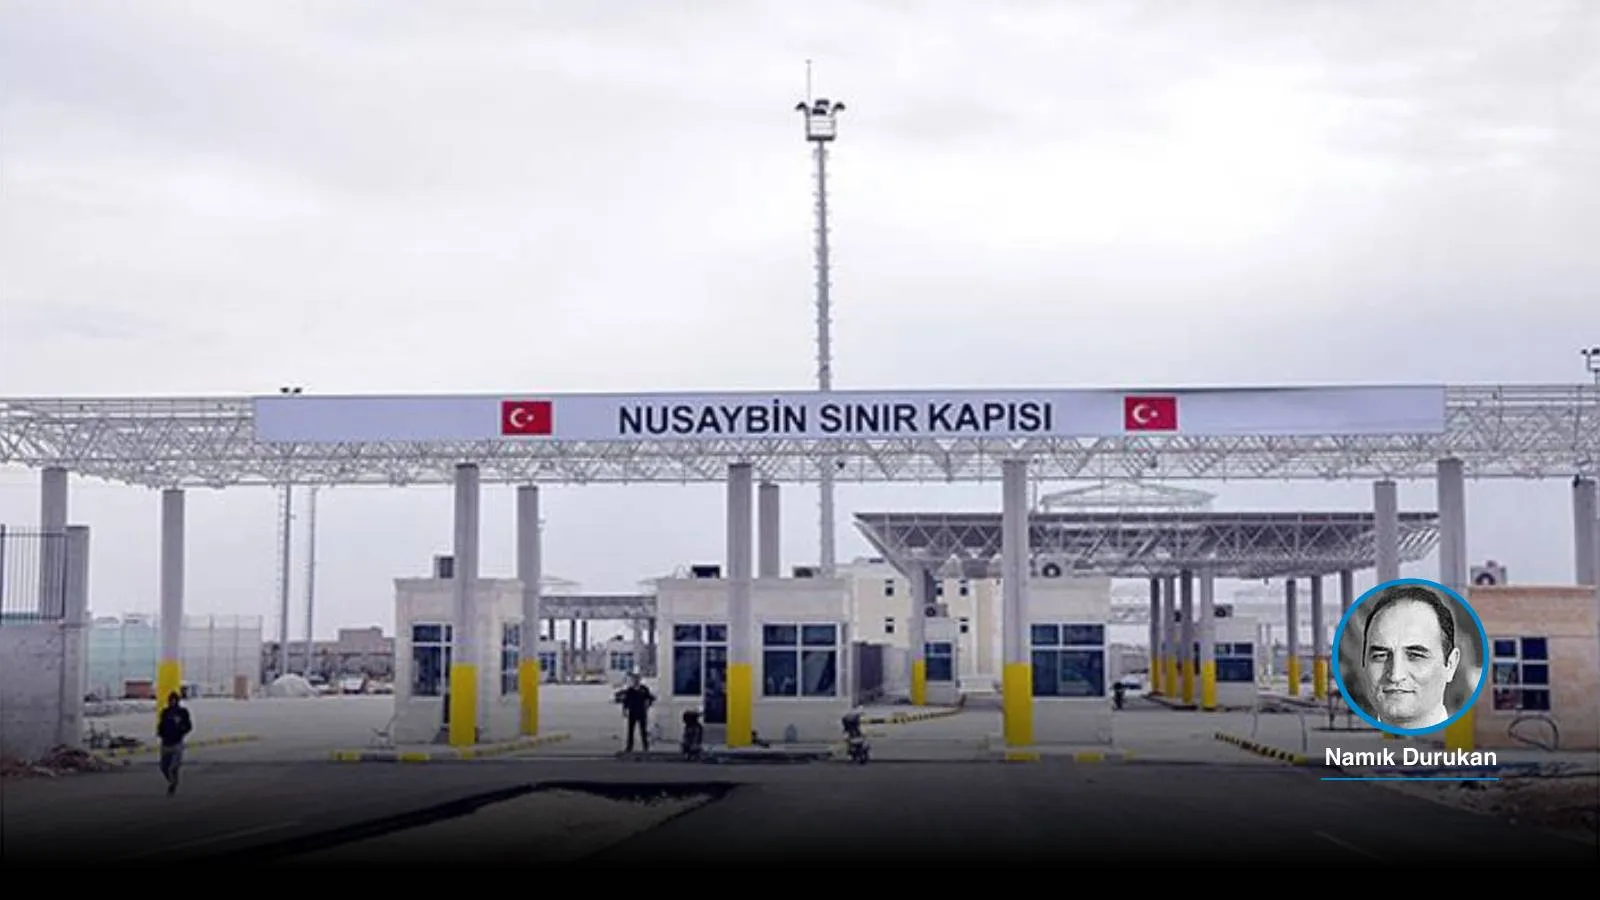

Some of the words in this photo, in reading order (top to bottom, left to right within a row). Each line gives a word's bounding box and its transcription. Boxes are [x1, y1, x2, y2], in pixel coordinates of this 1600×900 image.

[618, 398, 807, 435] NUSAYBİN
[819, 403, 919, 434] SINIR
[927, 402, 1053, 433] KAPISI
